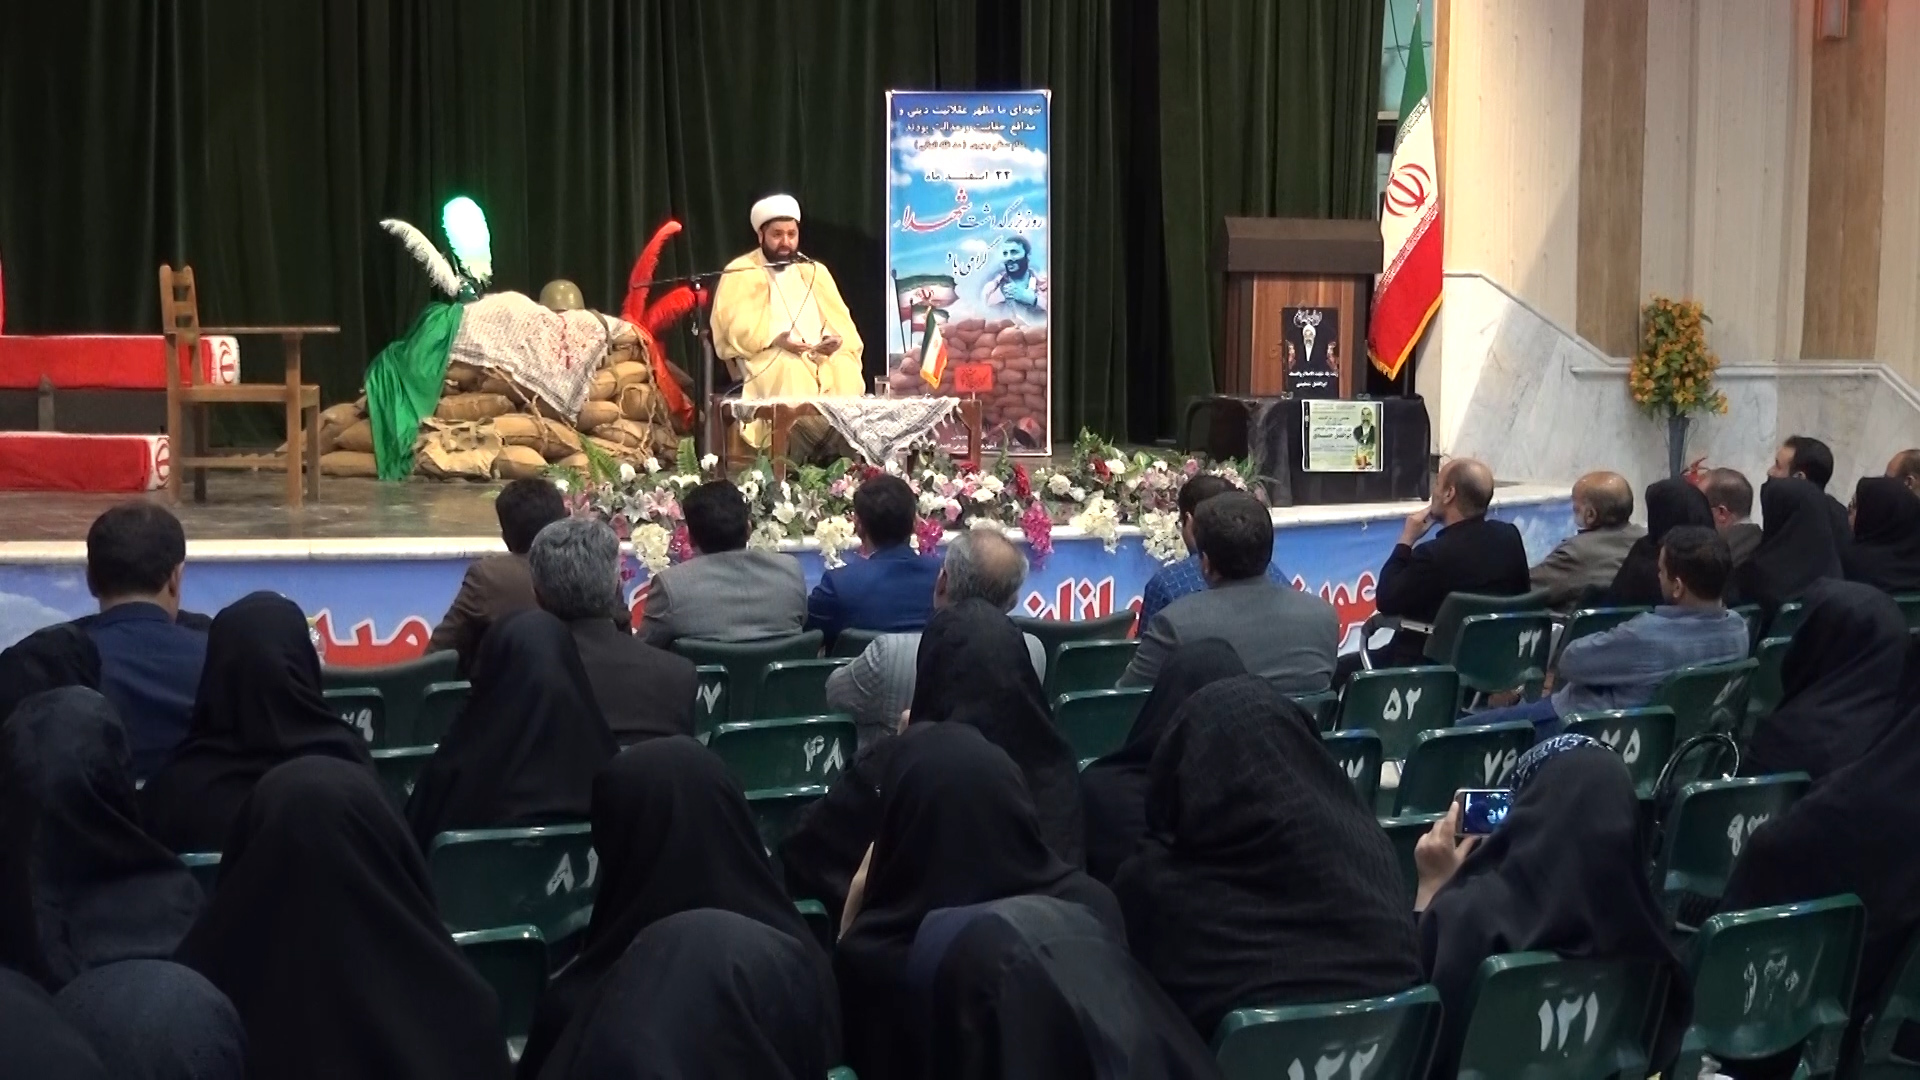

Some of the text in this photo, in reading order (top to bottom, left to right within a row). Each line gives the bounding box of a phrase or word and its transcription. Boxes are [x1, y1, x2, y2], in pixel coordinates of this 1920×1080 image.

[997, 104, 1006, 114] ما
[696, 681, 723, 714] ۷
[1382, 687, 1422, 721] ۵۲
[803, 735, 844, 775] ۴۸
[1338, 755, 1365, 780] ۷
[1538, 991, 1599, 1052] ۱۲۱
